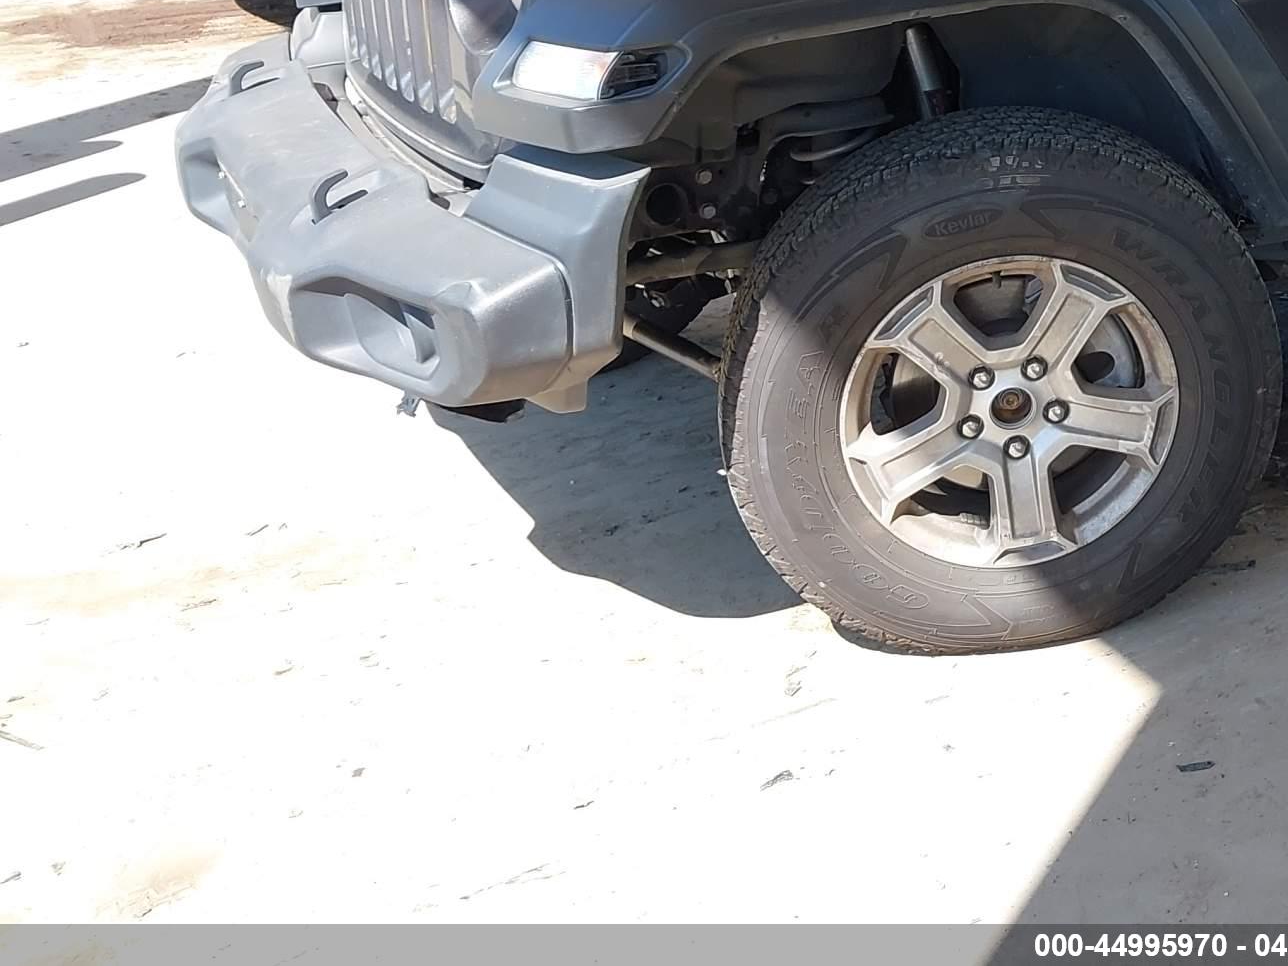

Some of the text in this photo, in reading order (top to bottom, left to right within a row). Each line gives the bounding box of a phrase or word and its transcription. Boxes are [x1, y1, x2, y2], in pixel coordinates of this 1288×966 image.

[934, 210, 993, 237] Kevlar
[783, 306, 930, 610] GOODYEAR
[1111, 224, 1233, 526] WRANGLER
